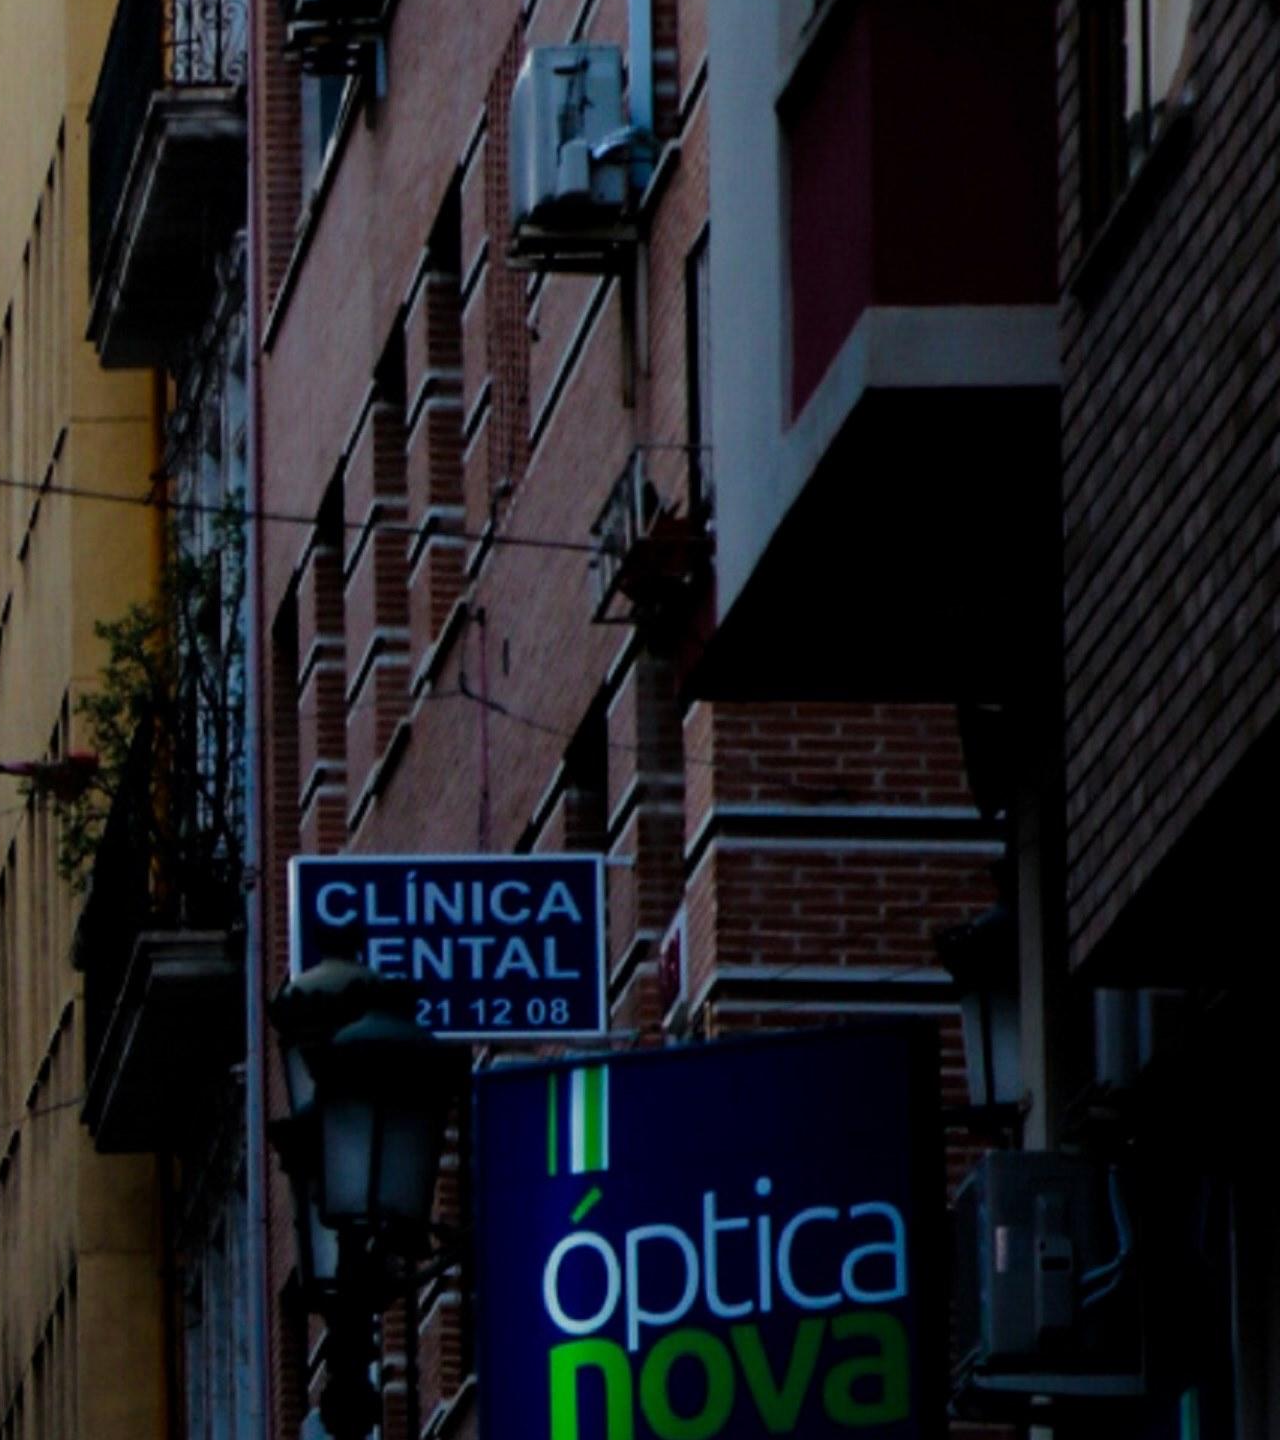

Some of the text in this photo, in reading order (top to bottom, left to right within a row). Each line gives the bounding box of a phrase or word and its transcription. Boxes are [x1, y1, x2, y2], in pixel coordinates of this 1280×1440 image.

[315, 869, 583, 927] CLÍNICA
[355, 935, 582, 981] ENTAL
[468, 997, 513, 1027] 12
[525, 997, 571, 1026] 08
[541, 1174, 911, 1353] óptica
